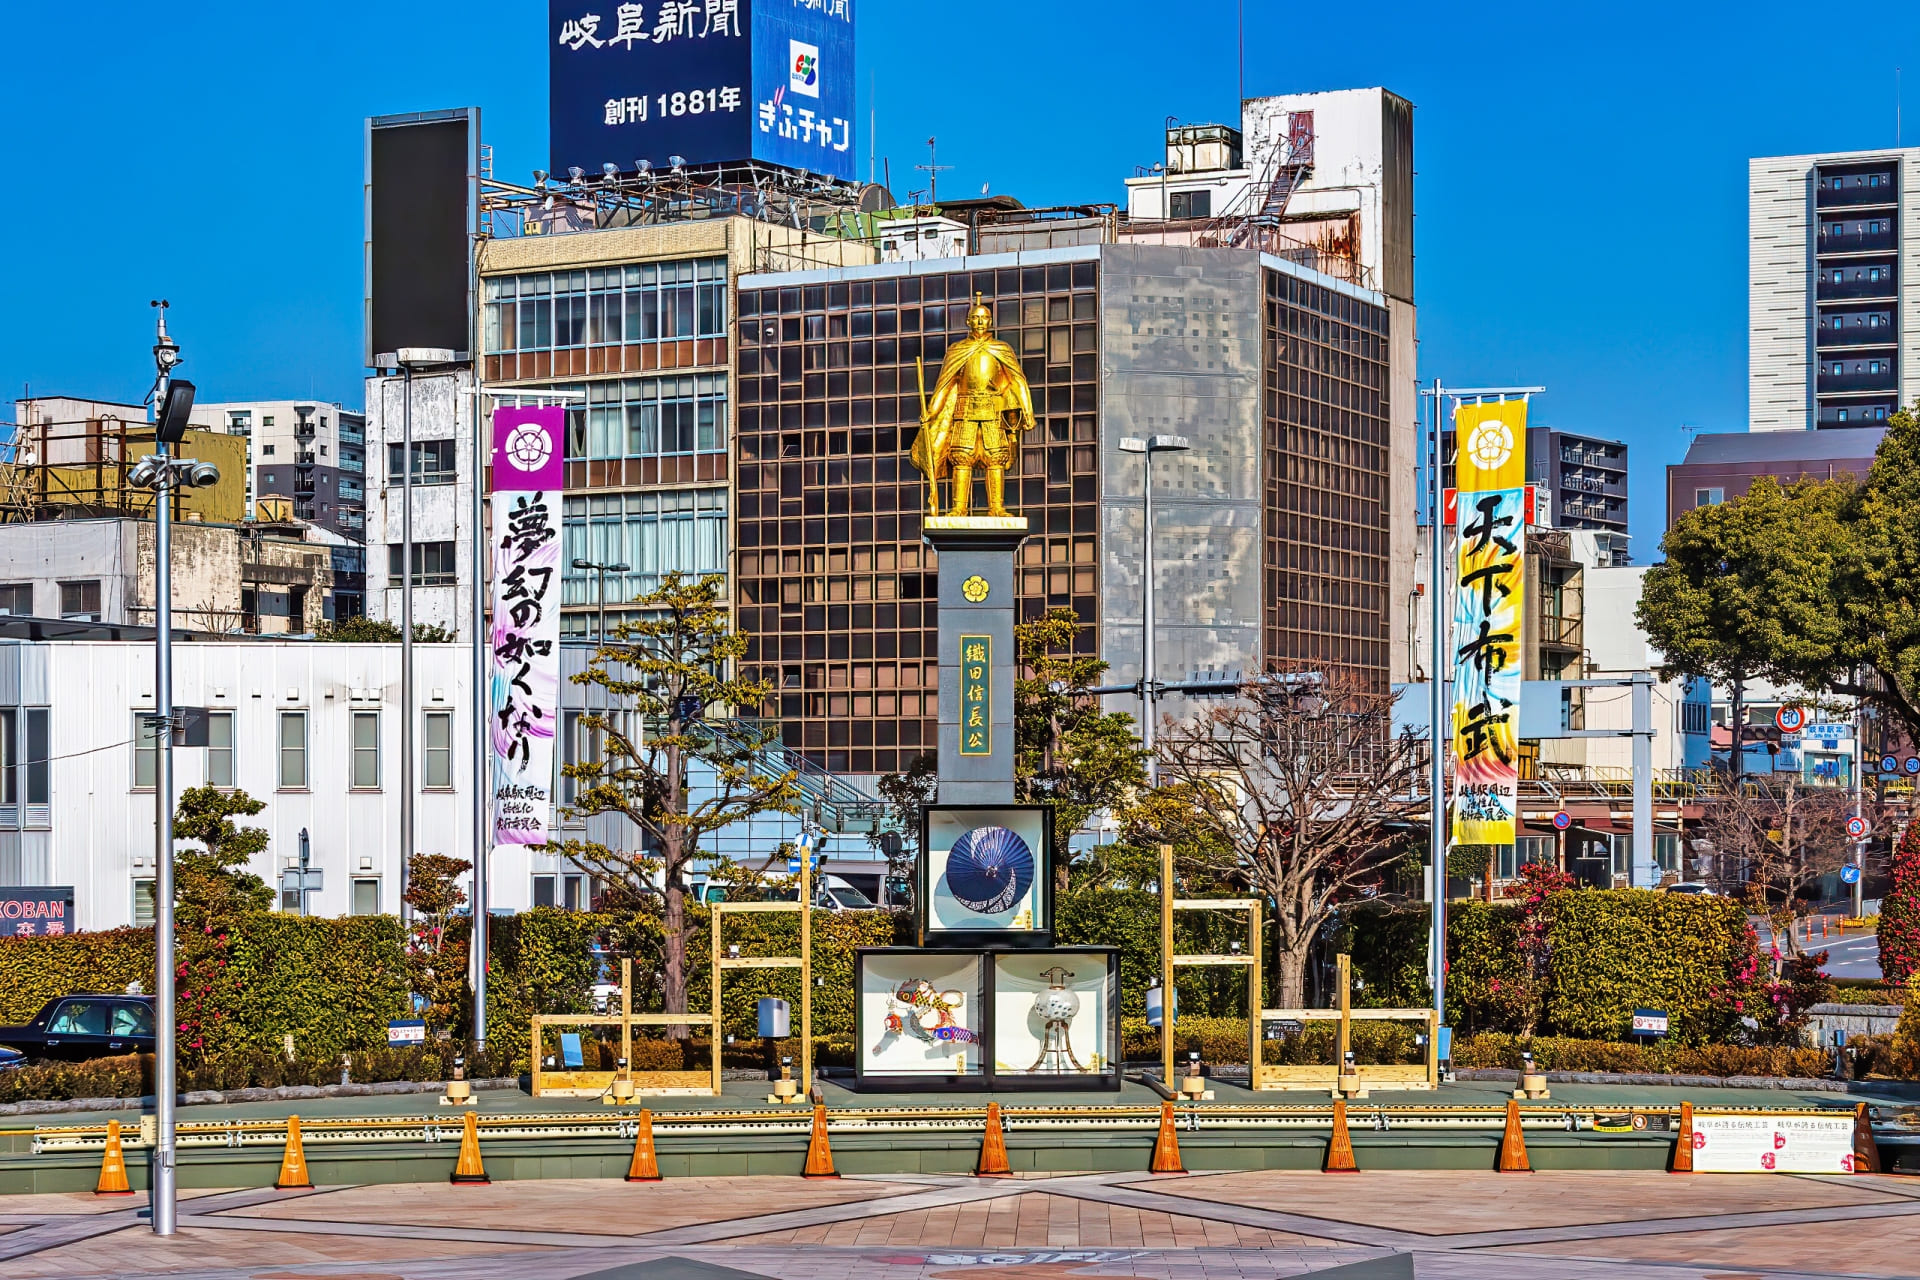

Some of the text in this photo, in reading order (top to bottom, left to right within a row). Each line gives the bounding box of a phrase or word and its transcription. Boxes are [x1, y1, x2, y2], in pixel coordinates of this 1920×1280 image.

[559, 0, 742, 51] 岐阜新聞
[604, 86, 742, 126] 創刊 1881年
[759, 84, 850, 152] ぎふチャン
[494, 490, 556, 777] 夢幻の如くなり
[1460, 493, 1519, 768] 天下布武
[965, 642, 987, 748] 織田信長公
[1907, 760, 1919, 770] 50
